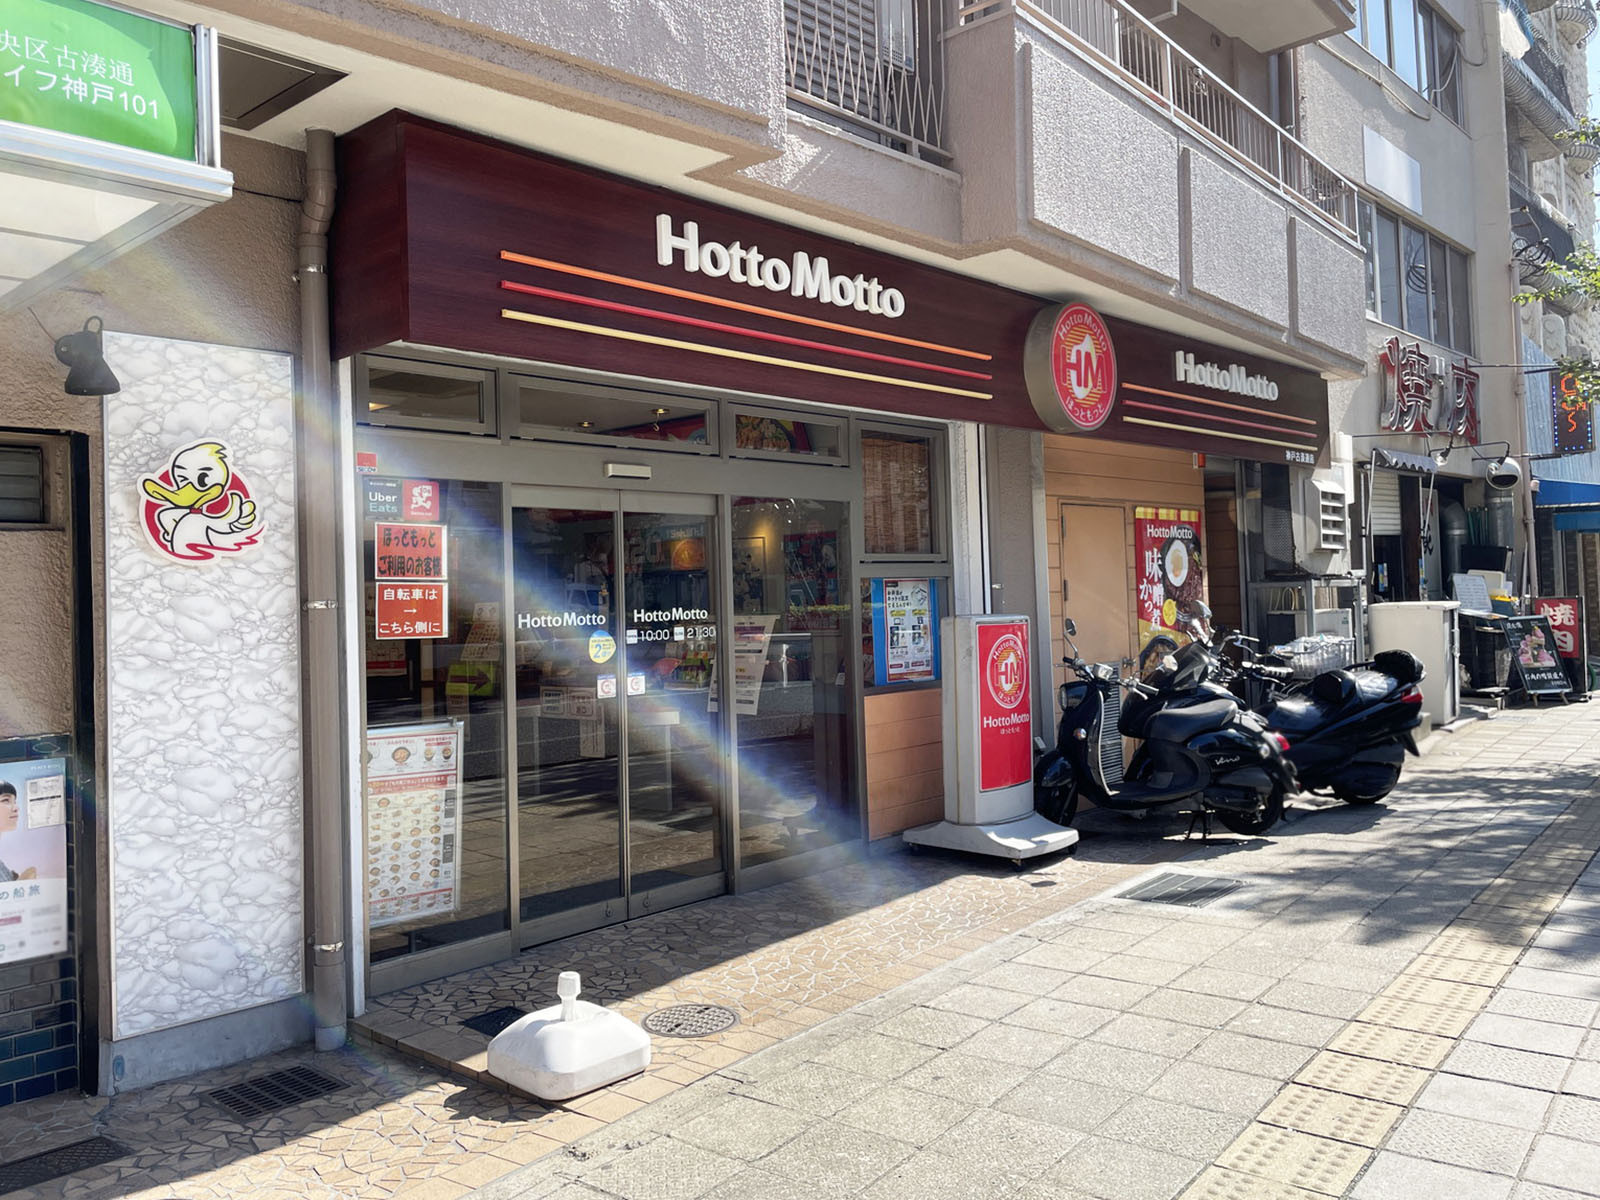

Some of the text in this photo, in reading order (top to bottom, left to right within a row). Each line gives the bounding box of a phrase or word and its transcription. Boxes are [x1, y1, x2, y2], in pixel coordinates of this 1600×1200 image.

[656, 213, 906, 319] HottoMotto
[1175, 350, 1279, 401] HottoMotto
[368, 491, 397, 502] Uber
[369, 502, 398, 513] Eats
[383, 528, 436, 548] ほっともっと
[1146, 525, 1193, 540] HottoMotto
[383, 588, 438, 601] 自転車は
[517, 612, 606, 629] HottoMotto
[633, 607, 708, 623] HottoMotto
[379, 621, 441, 634] こちら側に
[640, 629, 670, 642] 10:00
[686, 626, 717, 639] 21:30
[983, 712, 1030, 728] HottoMotto
